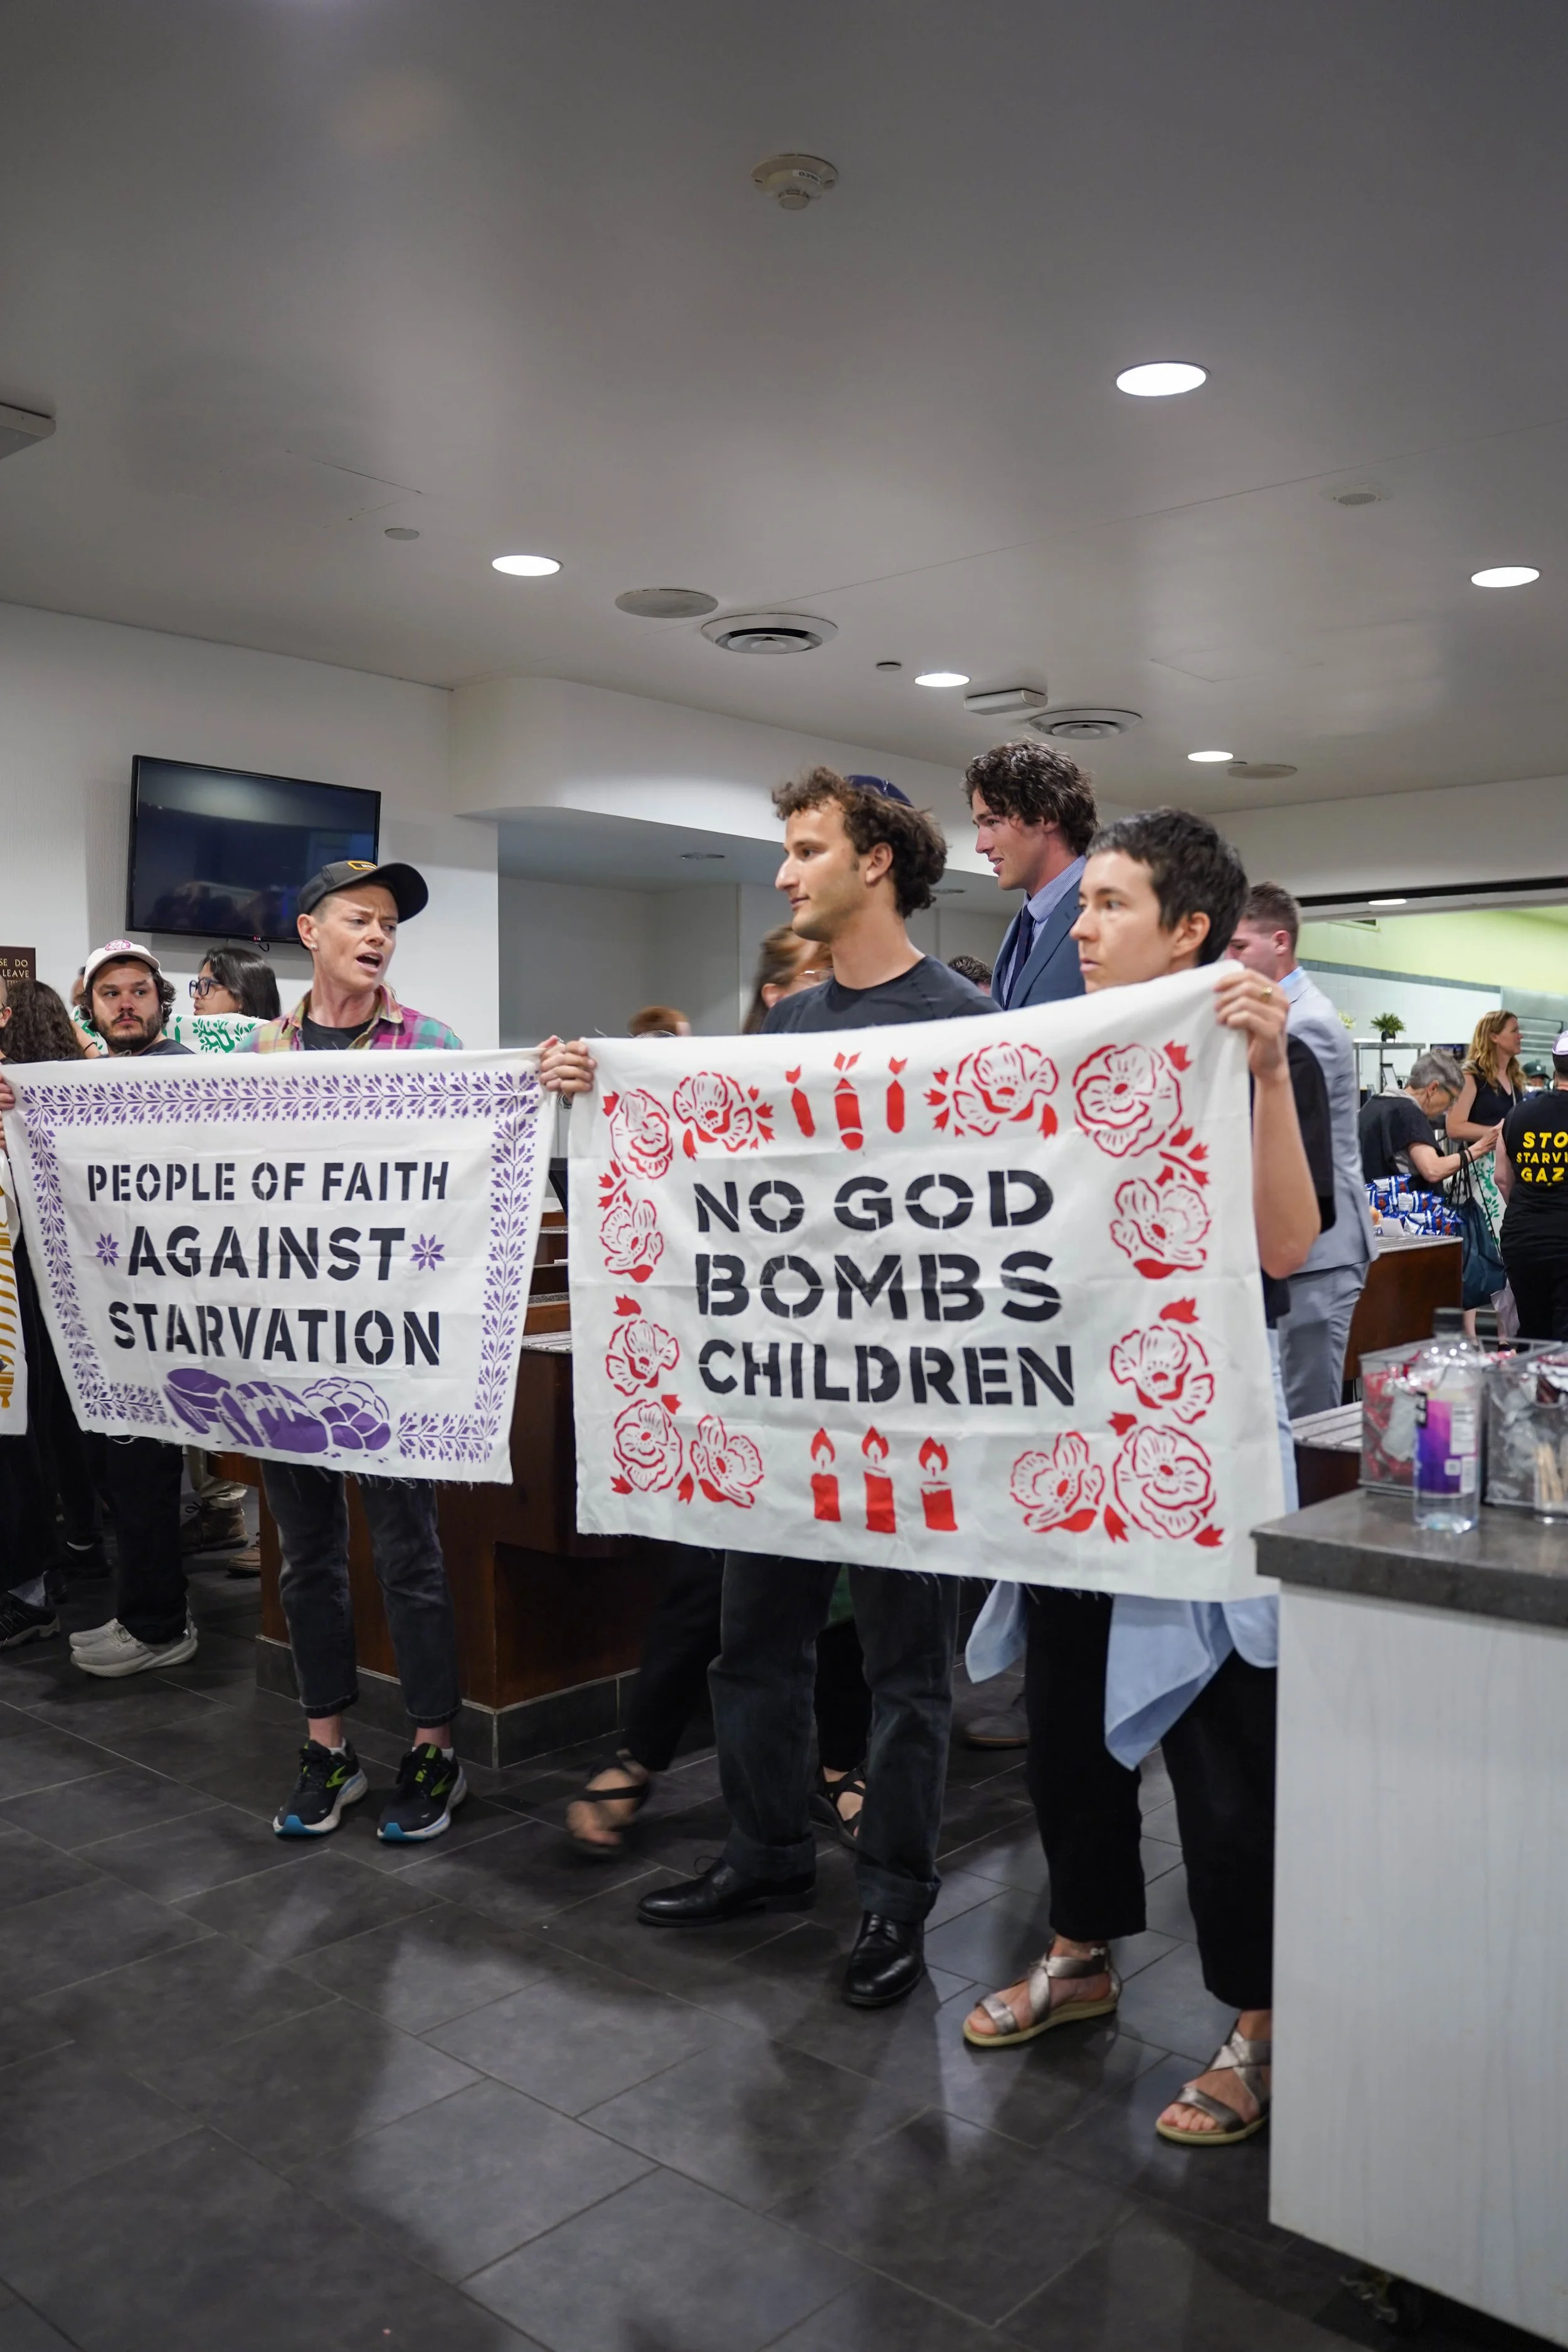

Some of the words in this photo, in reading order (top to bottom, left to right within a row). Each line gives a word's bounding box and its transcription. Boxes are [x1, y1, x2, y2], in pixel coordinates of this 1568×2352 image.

[3, 969, 29, 978] LEAVE
[15, 959, 28, 967] DO
[1522, 1131, 1568, 1149] STO
[88, 1163, 235, 1202] PEOPLE
[252, 1162, 305, 1201] OF
[322, 1162, 448, 1201] FAITH
[1520, 1167, 1565, 1182] GAZ
[694, 1180, 804, 1233] NO
[834, 1170, 1053, 1231] GOD
[128, 1226, 405, 1281] AGAINST
[696, 1251, 1061, 1322] BOMBS
[109, 1301, 439, 1365] STARVATION
[699, 1339, 1074, 1406] CHILDREN
